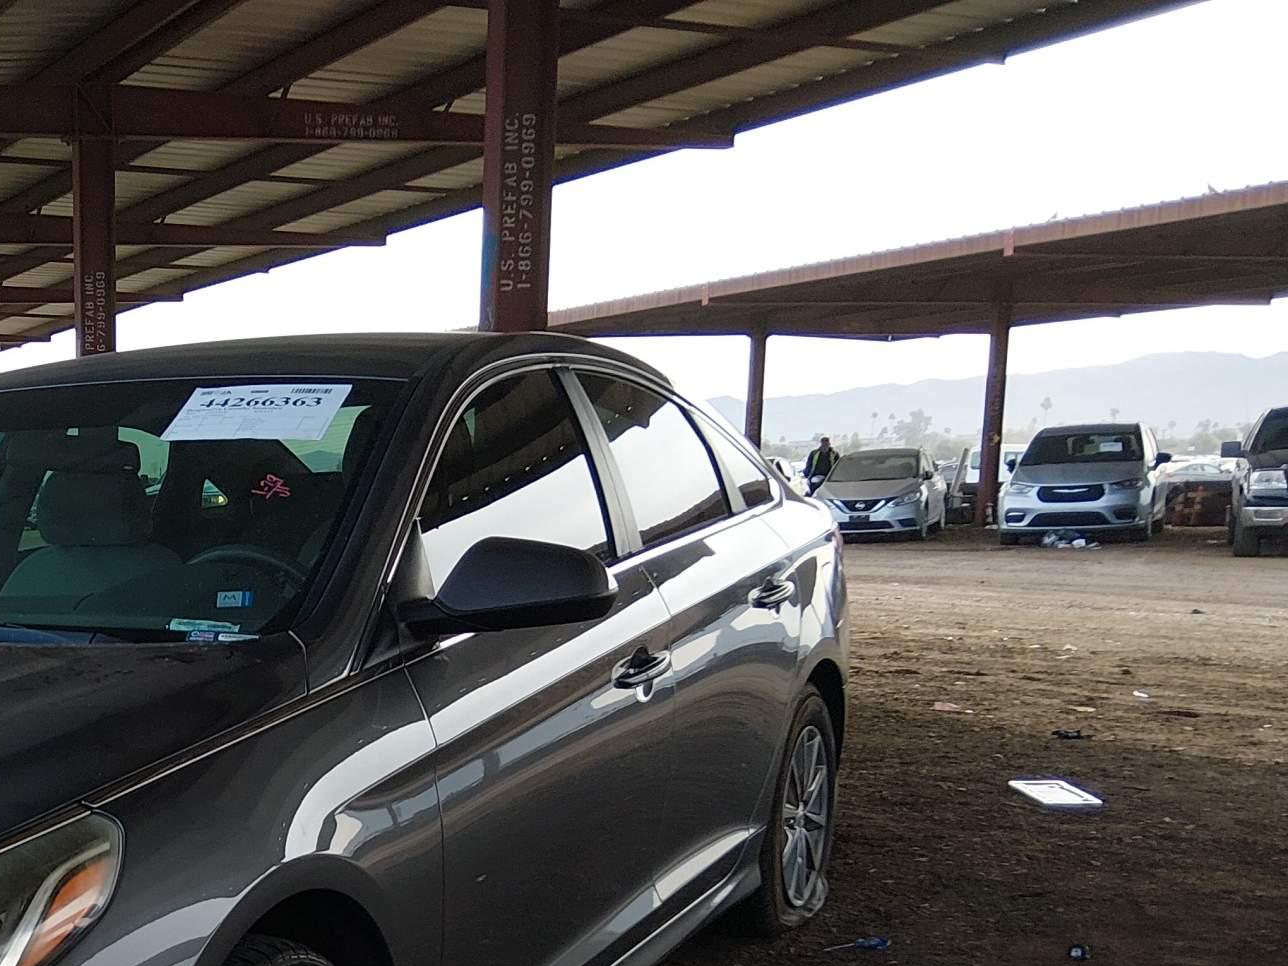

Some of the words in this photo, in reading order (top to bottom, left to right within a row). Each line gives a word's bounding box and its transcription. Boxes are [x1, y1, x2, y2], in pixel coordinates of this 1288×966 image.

[330, 112, 374, 126] PREFAB
[504, 112, 520, 151] INC.
[502, 161, 518, 242] PREFAB
[516, 113, 537, 290] 1-866-799-0969
[499, 253, 515, 292] U.S.
[84, 301, 95, 352] PREFAB
[199, 396, 323, 409] 44266363
